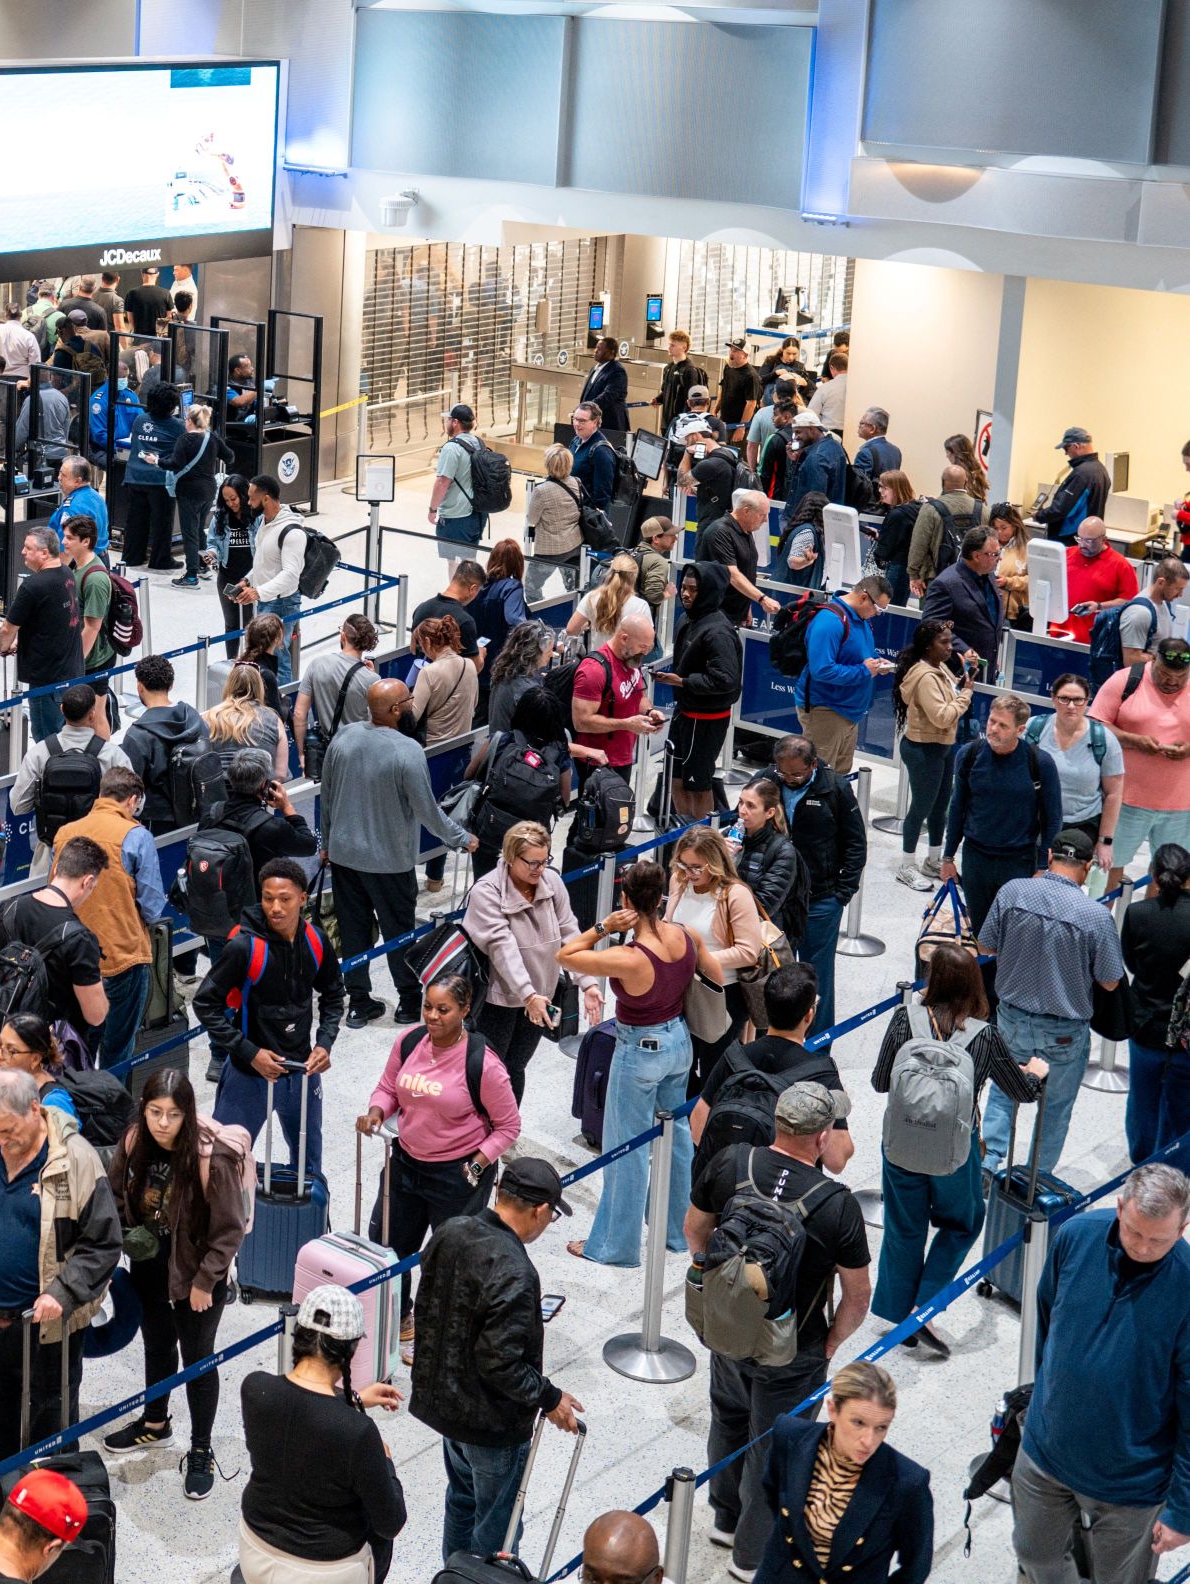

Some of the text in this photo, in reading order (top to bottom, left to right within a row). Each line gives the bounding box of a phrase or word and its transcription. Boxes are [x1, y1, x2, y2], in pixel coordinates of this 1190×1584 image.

[100, 248, 161, 267] JCDecaux
[138, 434, 157, 442] CLEAR
[771, 681, 786, 693] Less
[399, 1073, 443, 1096] nike
[773, 1168, 790, 1203] PUMA
[118, 1399, 140, 1412] UNITED
[34, 1440, 57, 1455] UNITED
